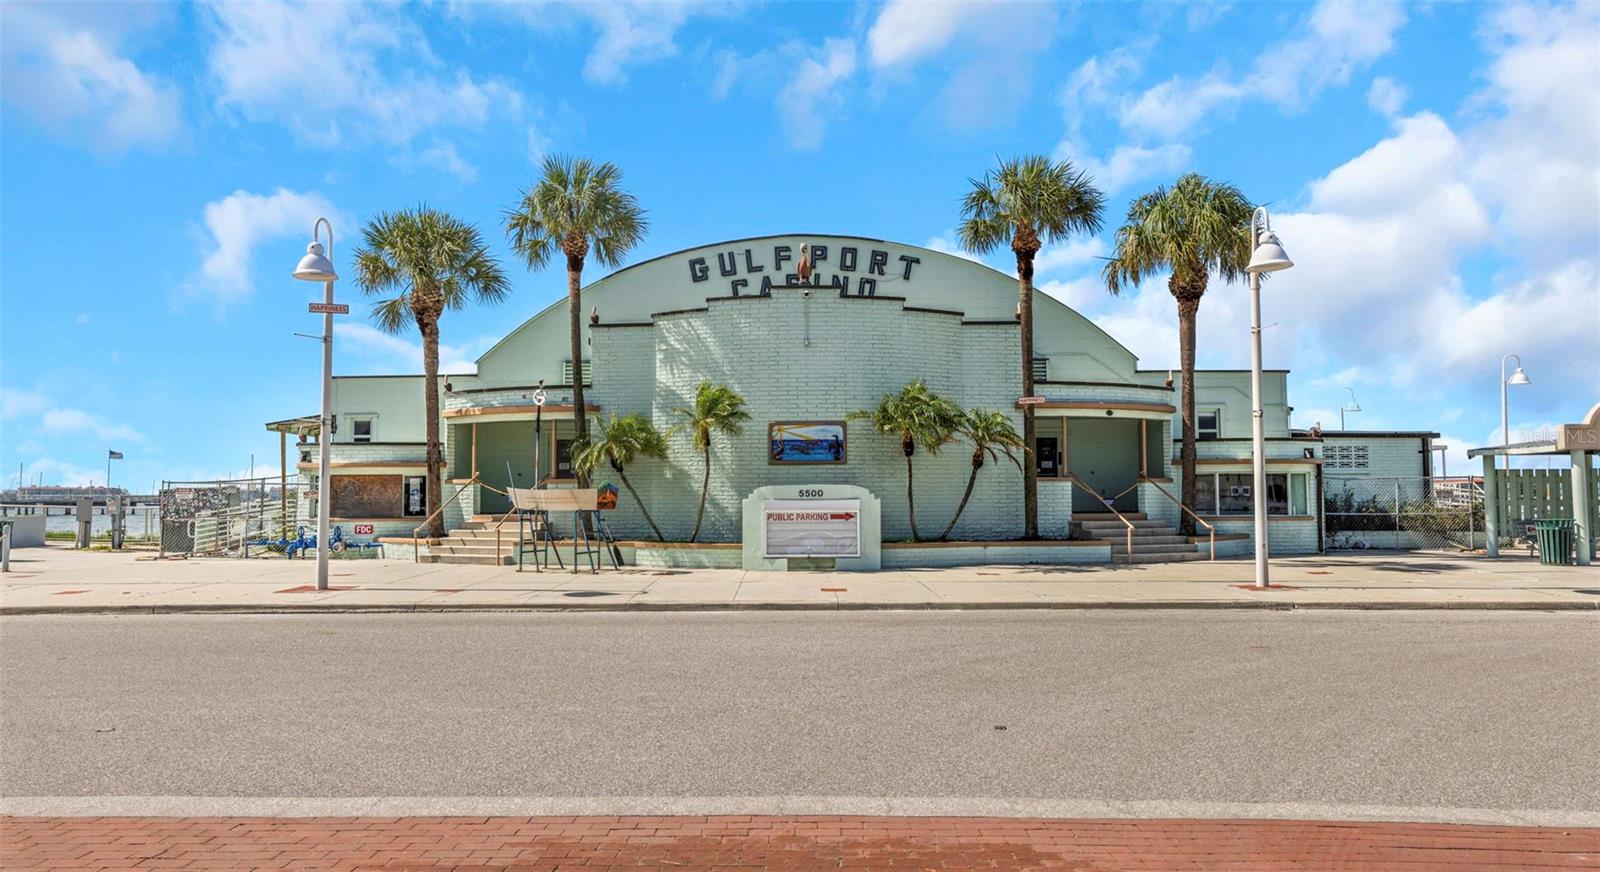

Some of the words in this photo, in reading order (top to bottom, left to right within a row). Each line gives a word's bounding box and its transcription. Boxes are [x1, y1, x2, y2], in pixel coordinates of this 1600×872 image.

[689, 245, 921, 282] GULFPORT
[767, 513, 794, 521] PUBLIC
[796, 513, 828, 521] PARKING
[356, 526, 372, 534] FDC
